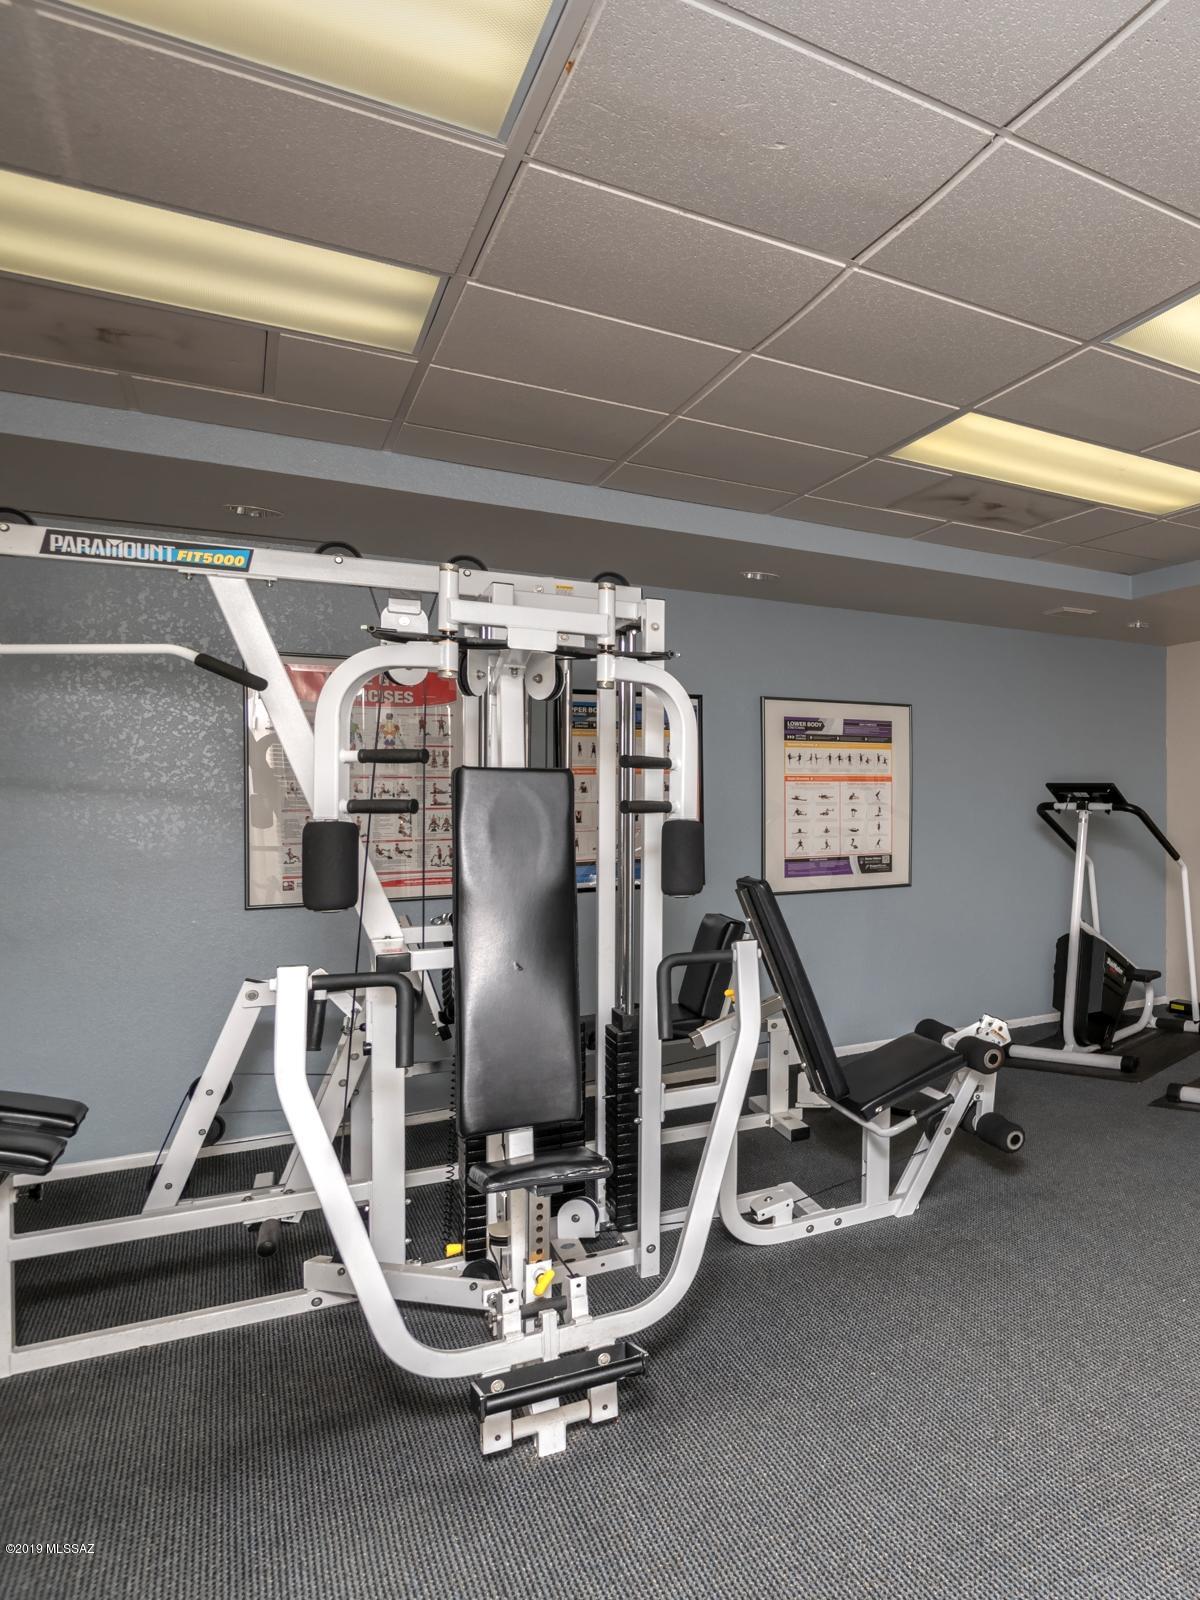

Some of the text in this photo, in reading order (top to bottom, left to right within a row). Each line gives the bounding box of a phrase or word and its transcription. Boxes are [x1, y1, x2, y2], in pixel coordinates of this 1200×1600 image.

[49, 534, 246, 567] PARAMOUNT FIT5000
[807, 721, 823, 729] BODY
